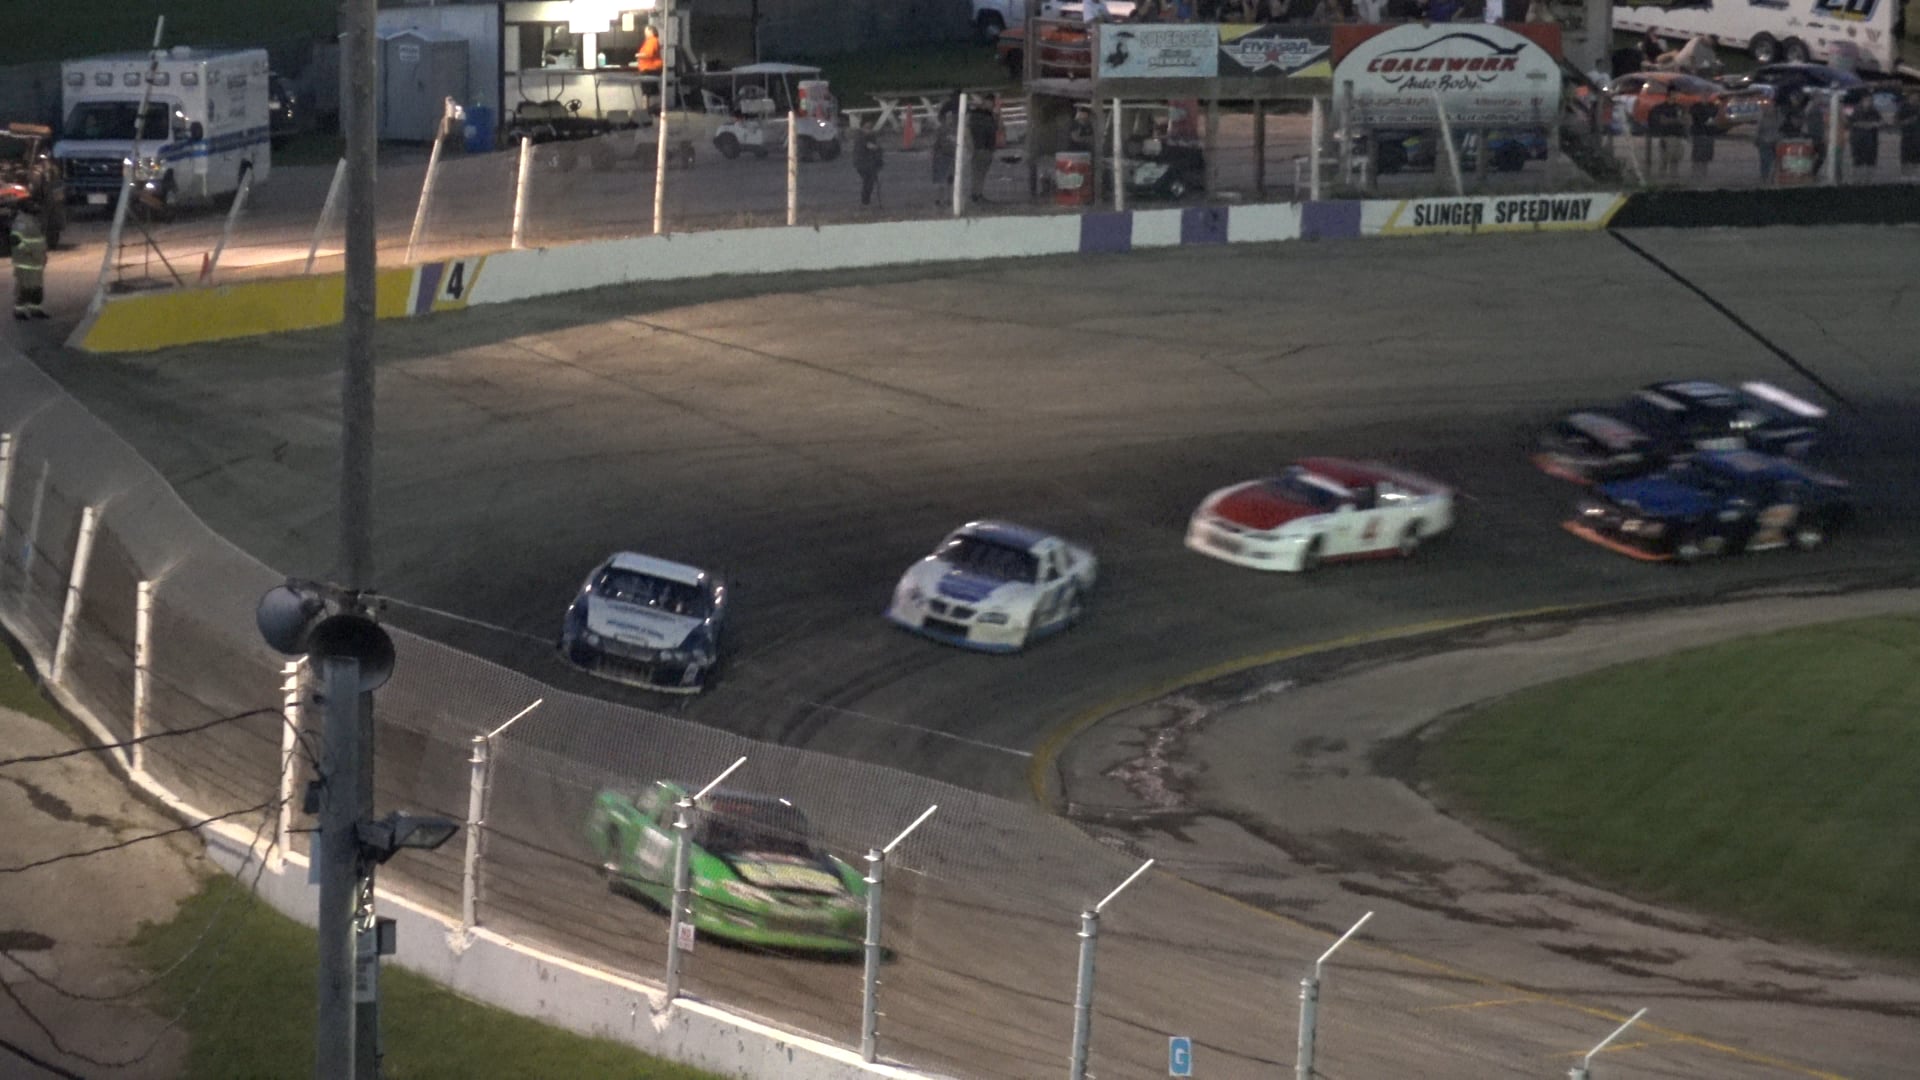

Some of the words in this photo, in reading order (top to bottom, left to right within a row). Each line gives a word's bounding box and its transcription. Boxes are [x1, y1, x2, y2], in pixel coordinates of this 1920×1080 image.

[1367, 57, 1518, 73] COACHWORK
[1398, 75, 1435, 92] Auto
[1438, 74, 1478, 92] Body
[1414, 202, 1485, 227] SLINGER
[1494, 198, 1593, 224] SPEEDWAY
[446, 261, 465, 300] 4
